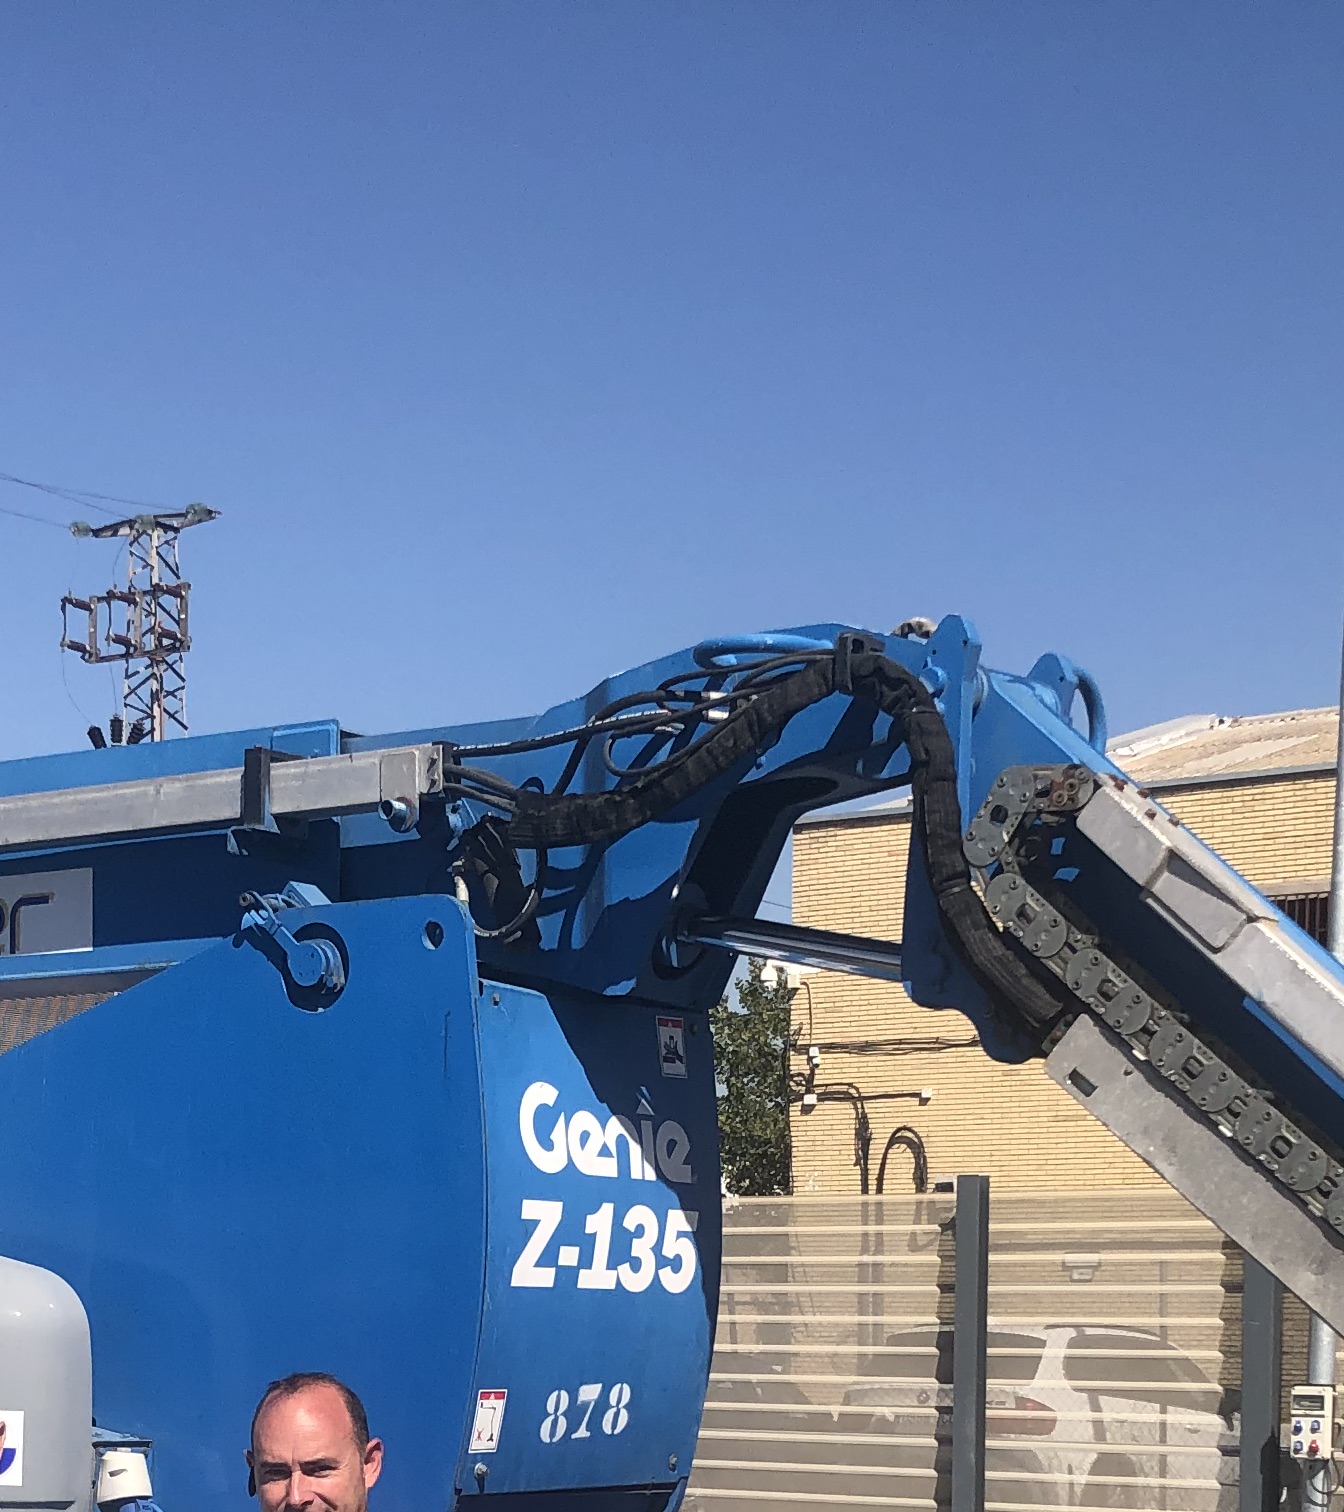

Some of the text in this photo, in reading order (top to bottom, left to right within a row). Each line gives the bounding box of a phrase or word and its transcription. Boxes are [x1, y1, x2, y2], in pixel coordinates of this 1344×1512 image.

[519, 1081, 694, 1184] Genie
[510, 1199, 699, 1294] Z-135
[540, 1382, 631, 1444] 878
